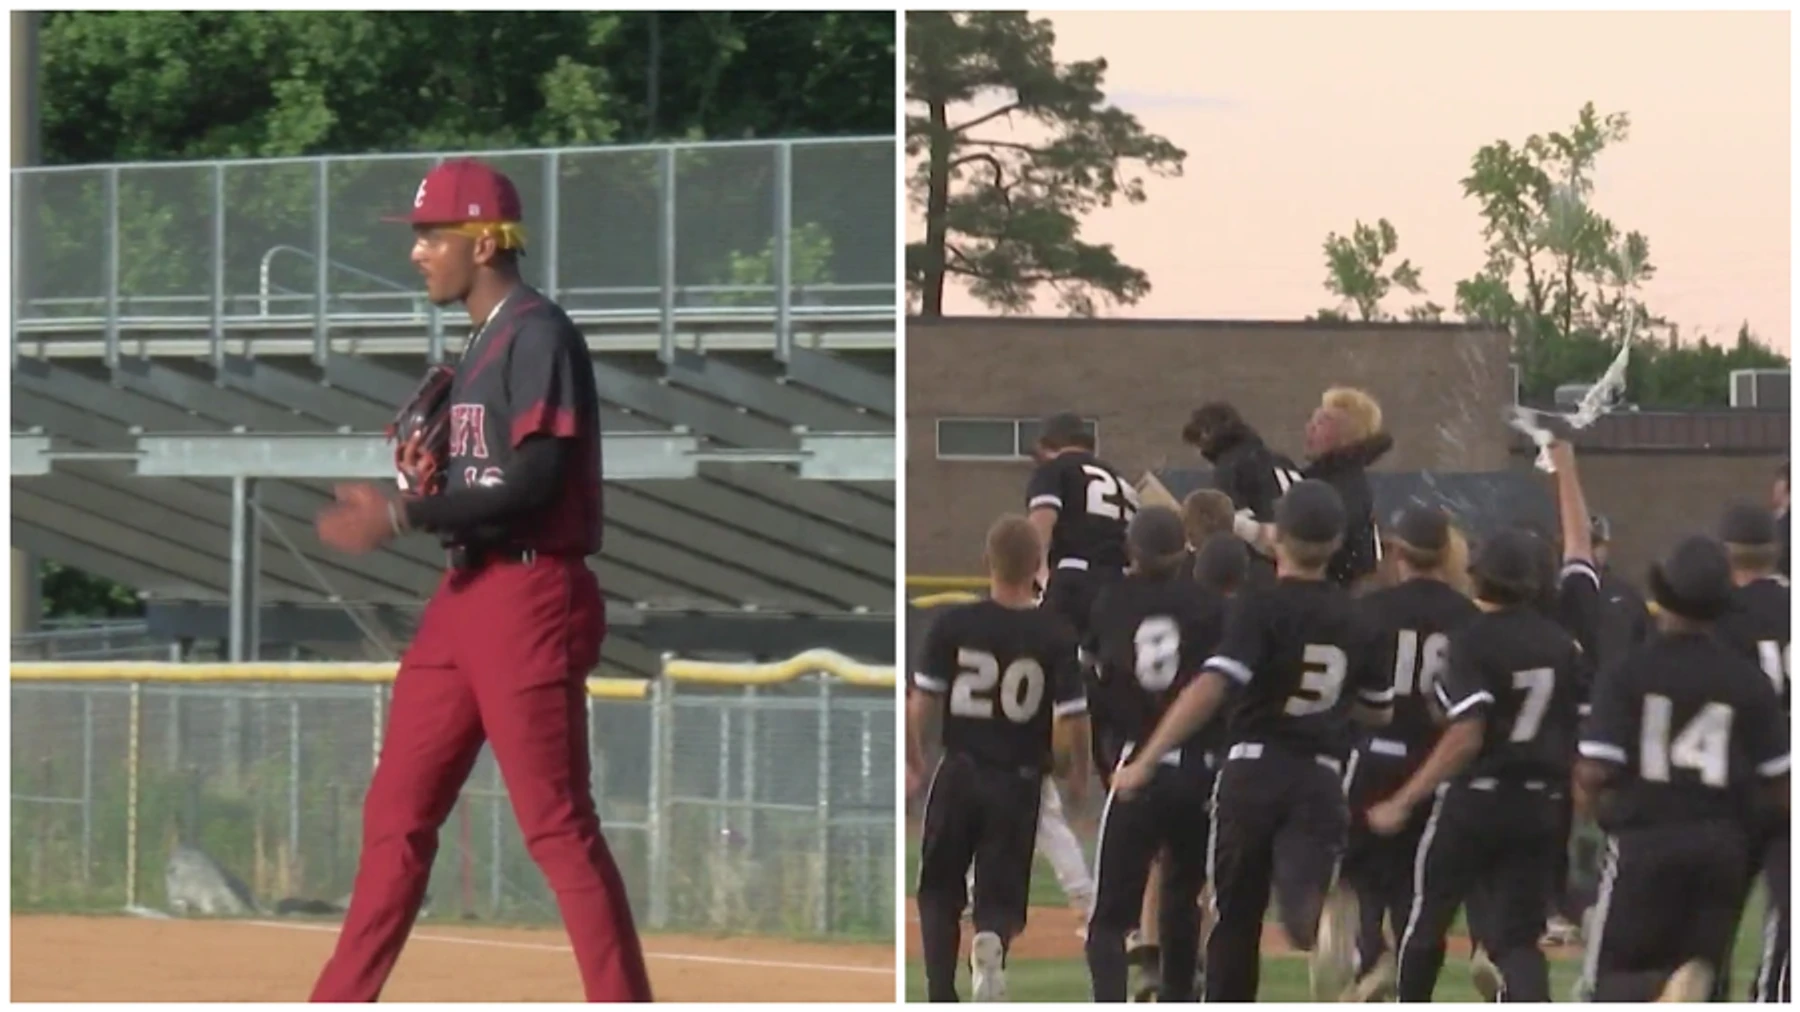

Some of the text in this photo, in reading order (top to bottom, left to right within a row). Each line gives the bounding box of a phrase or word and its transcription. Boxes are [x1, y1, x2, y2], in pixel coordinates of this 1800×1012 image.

[950, 648, 1045, 723] 20
[1284, 644, 1347, 716] 3
[1509, 668, 1555, 742] 7
[1640, 693, 1733, 787] 14
